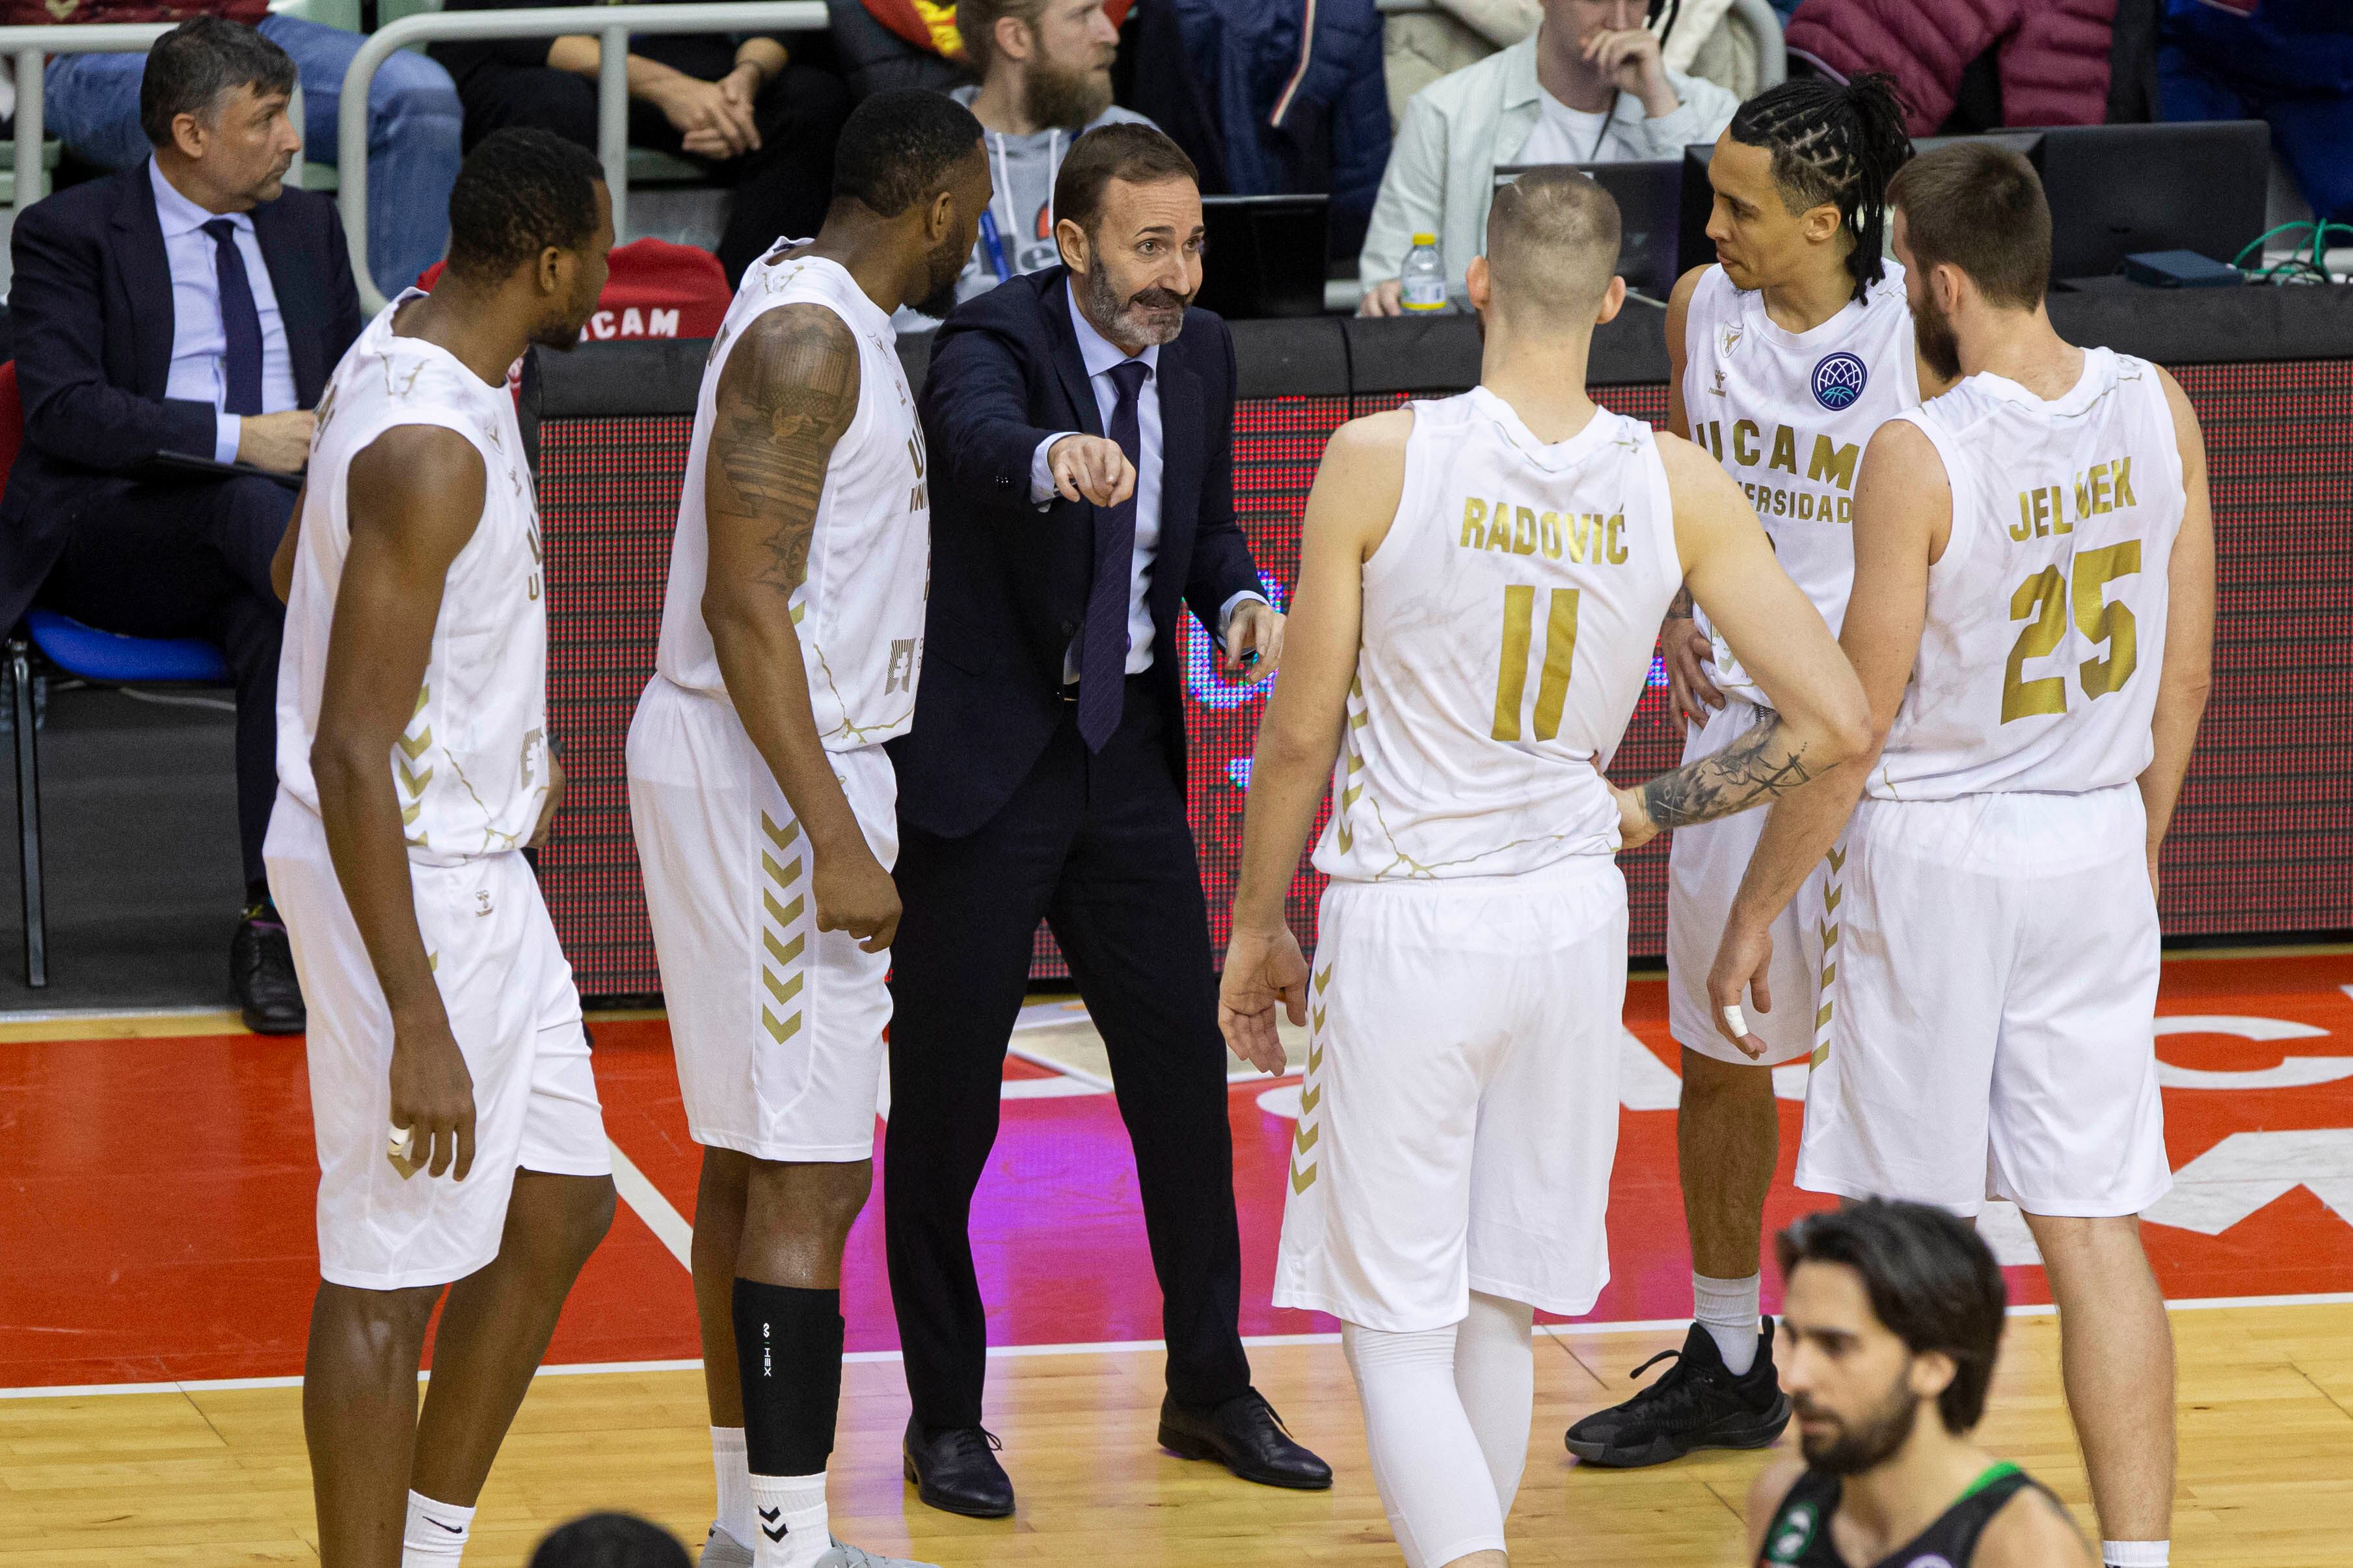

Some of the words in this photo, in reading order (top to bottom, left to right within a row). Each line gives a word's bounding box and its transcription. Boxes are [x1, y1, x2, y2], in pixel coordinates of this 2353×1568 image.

[580, 308, 680, 342] CAM
[1696, 419, 1860, 490] UCAM
[1460, 497, 1628, 565] RADOVIĆ
[1738, 482, 1853, 524] ERSIDAD
[1490, 585, 1580, 742] 11
[2000, 539, 2141, 725] 25
